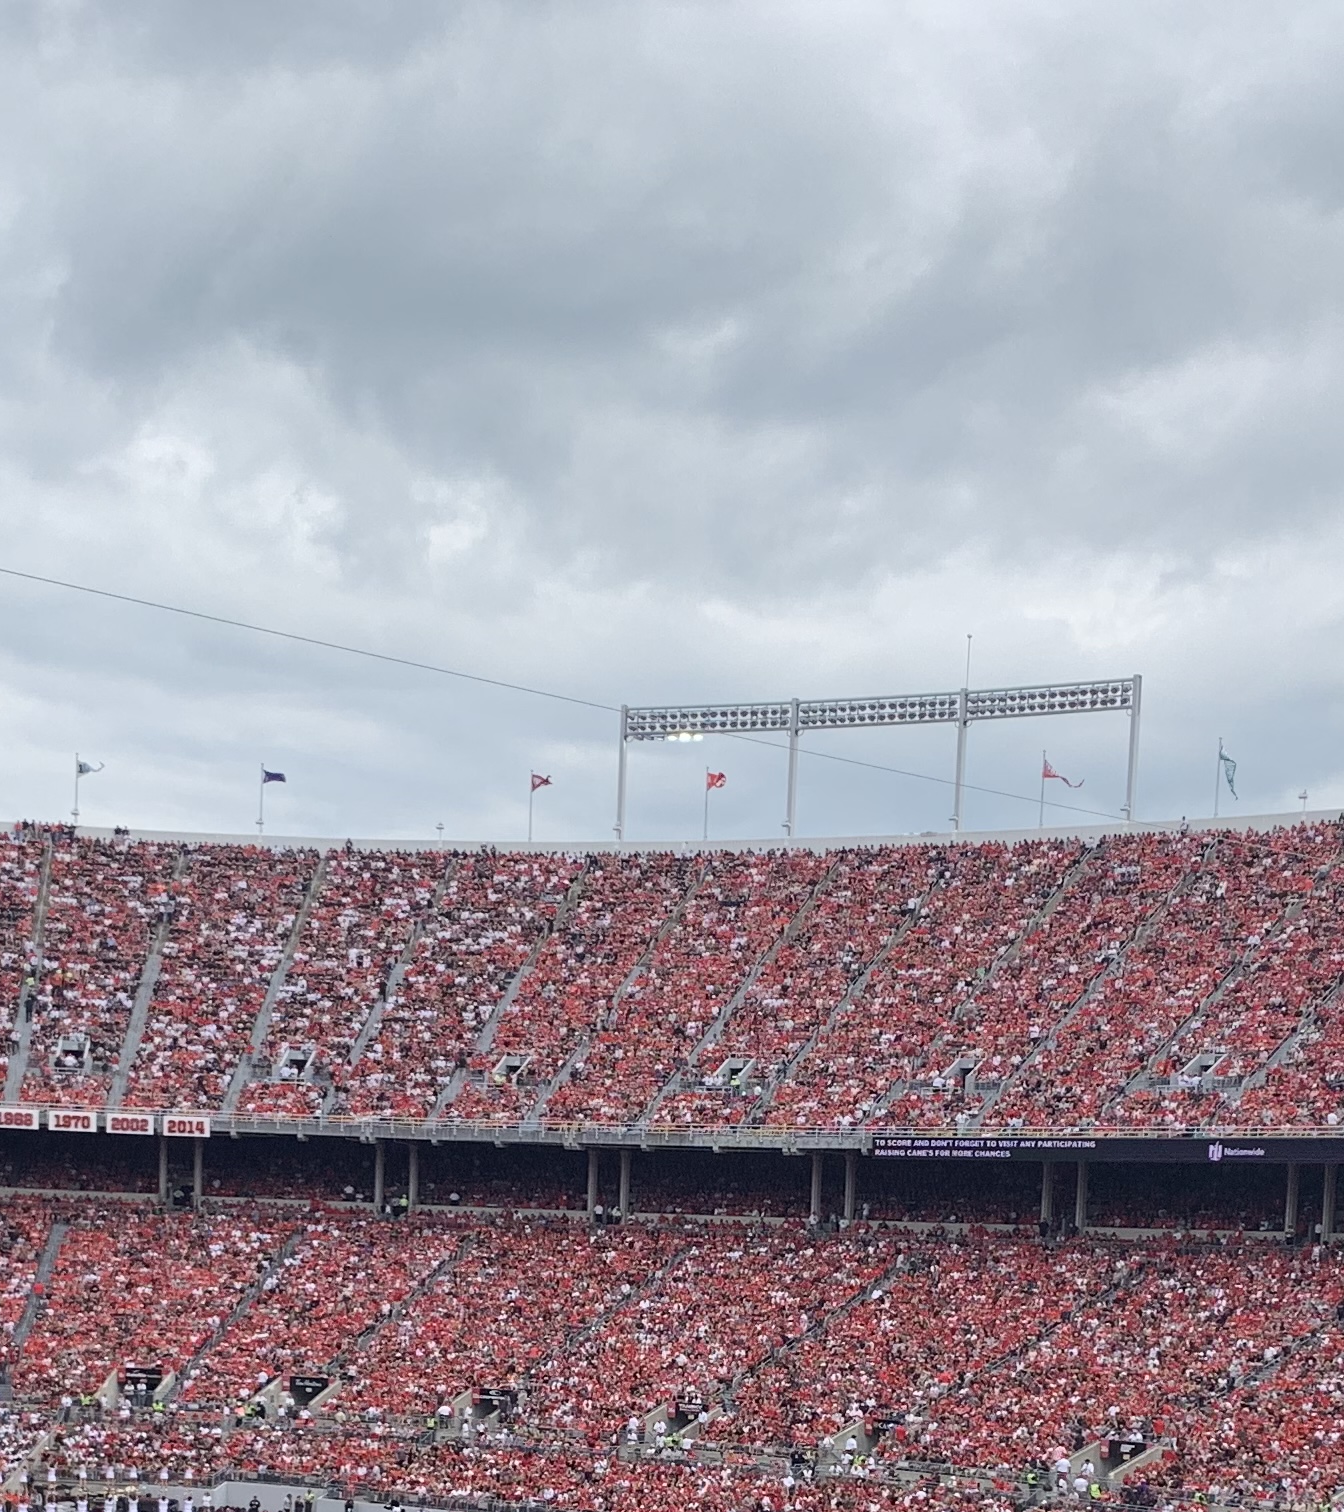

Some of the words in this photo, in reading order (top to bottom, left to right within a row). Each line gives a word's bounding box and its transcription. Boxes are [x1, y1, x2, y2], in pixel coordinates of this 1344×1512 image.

[54, 1113, 91, 1129] 1970
[111, 1117, 149, 1132] 2002
[167, 1120, 206, 1134] 2014
[887, 1139, 912, 1147] SCORE
[913, 1139, 929, 1147] AND
[955, 1139, 984, 1148] FORGET
[986, 1139, 997, 1148] TO
[998, 1139, 1018, 1148] VISIT
[1019, 1139, 1036, 1148] ANY
[1037, 1139, 1096, 1149] PARTICIPATING
[875, 1149, 905, 1157] RAISING
[935, 1149, 950, 1157] FOR
[1224, 1147, 1265, 1156] Nationwide
